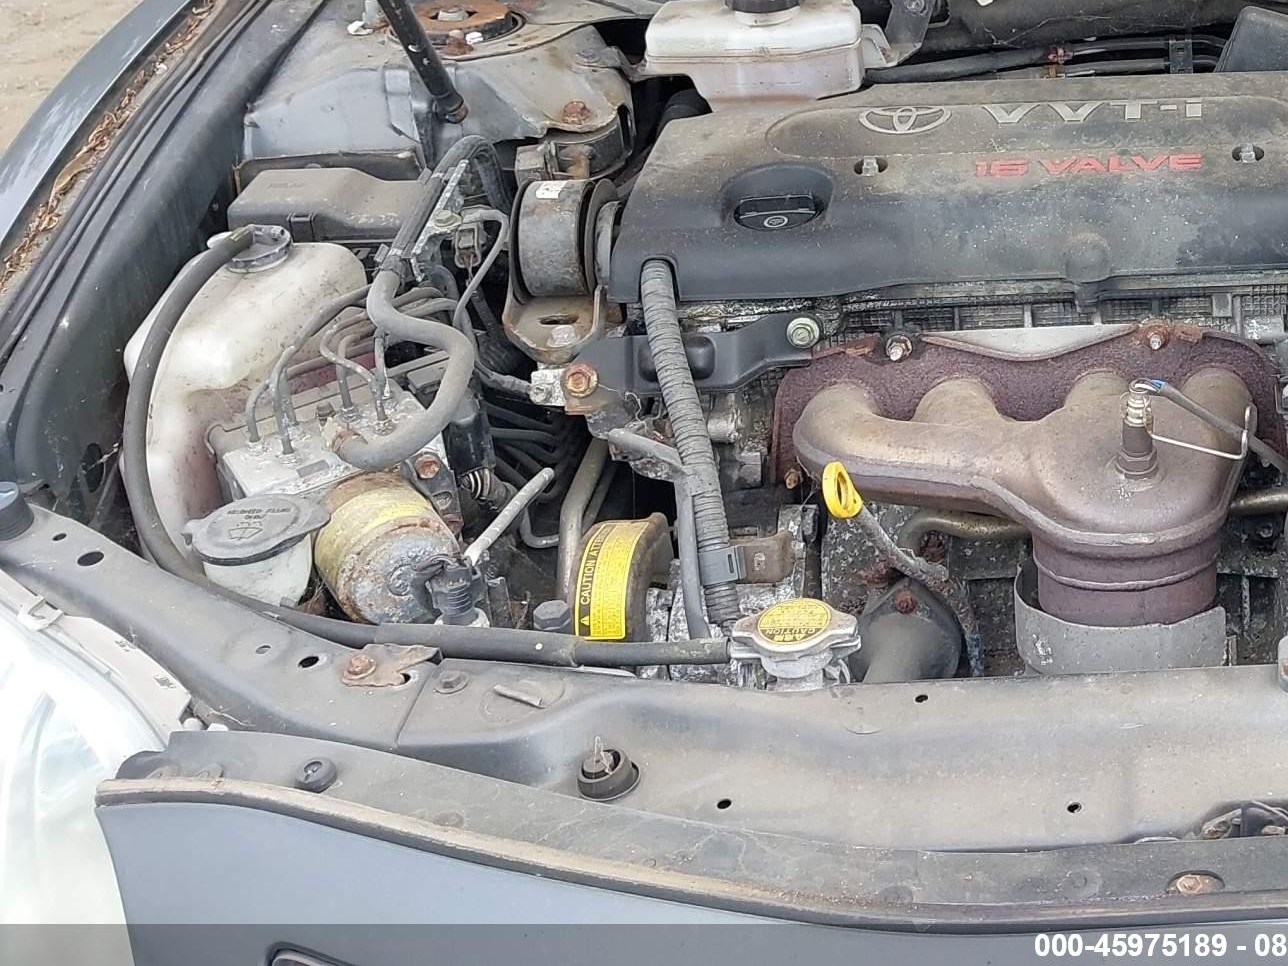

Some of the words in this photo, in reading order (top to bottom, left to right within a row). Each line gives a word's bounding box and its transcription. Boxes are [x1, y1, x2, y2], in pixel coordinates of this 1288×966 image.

[975, 158, 1028, 178] 16
[1037, 153, 1202, 175] VALVE
[580, 559, 597, 605] CAUTION
[765, 627, 816, 635] CAUTION
